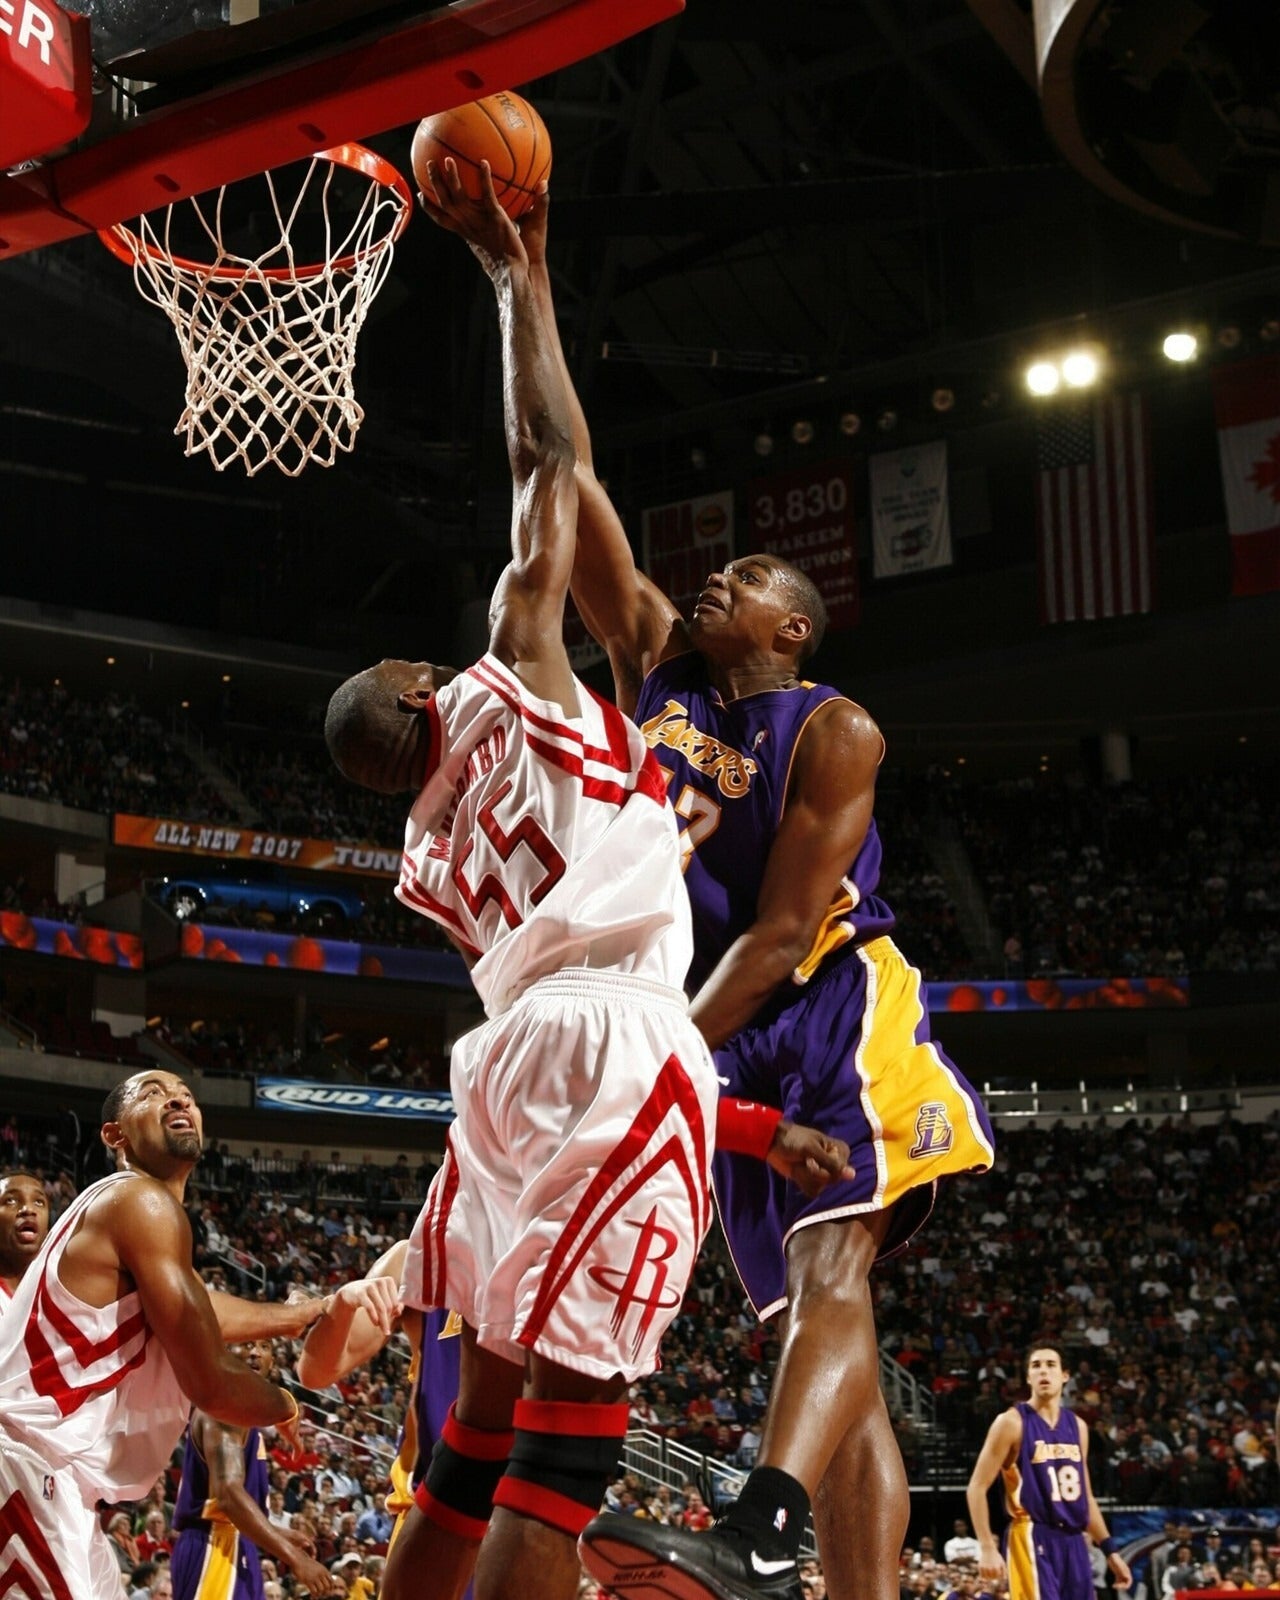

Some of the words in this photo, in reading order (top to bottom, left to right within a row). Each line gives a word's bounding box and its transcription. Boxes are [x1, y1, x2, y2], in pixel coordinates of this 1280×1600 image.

[754, 477, 848, 531] 3,830
[640, 699, 758, 799] LAKERS
[154, 823, 241, 851] ALL-NEW
[251, 835, 303, 861] 2007
[334, 846, 401, 873] TUN
[452, 779, 568, 931] 55
[284, 1088, 371, 1105] BUD
[1047, 1465, 1082, 1502] 18
